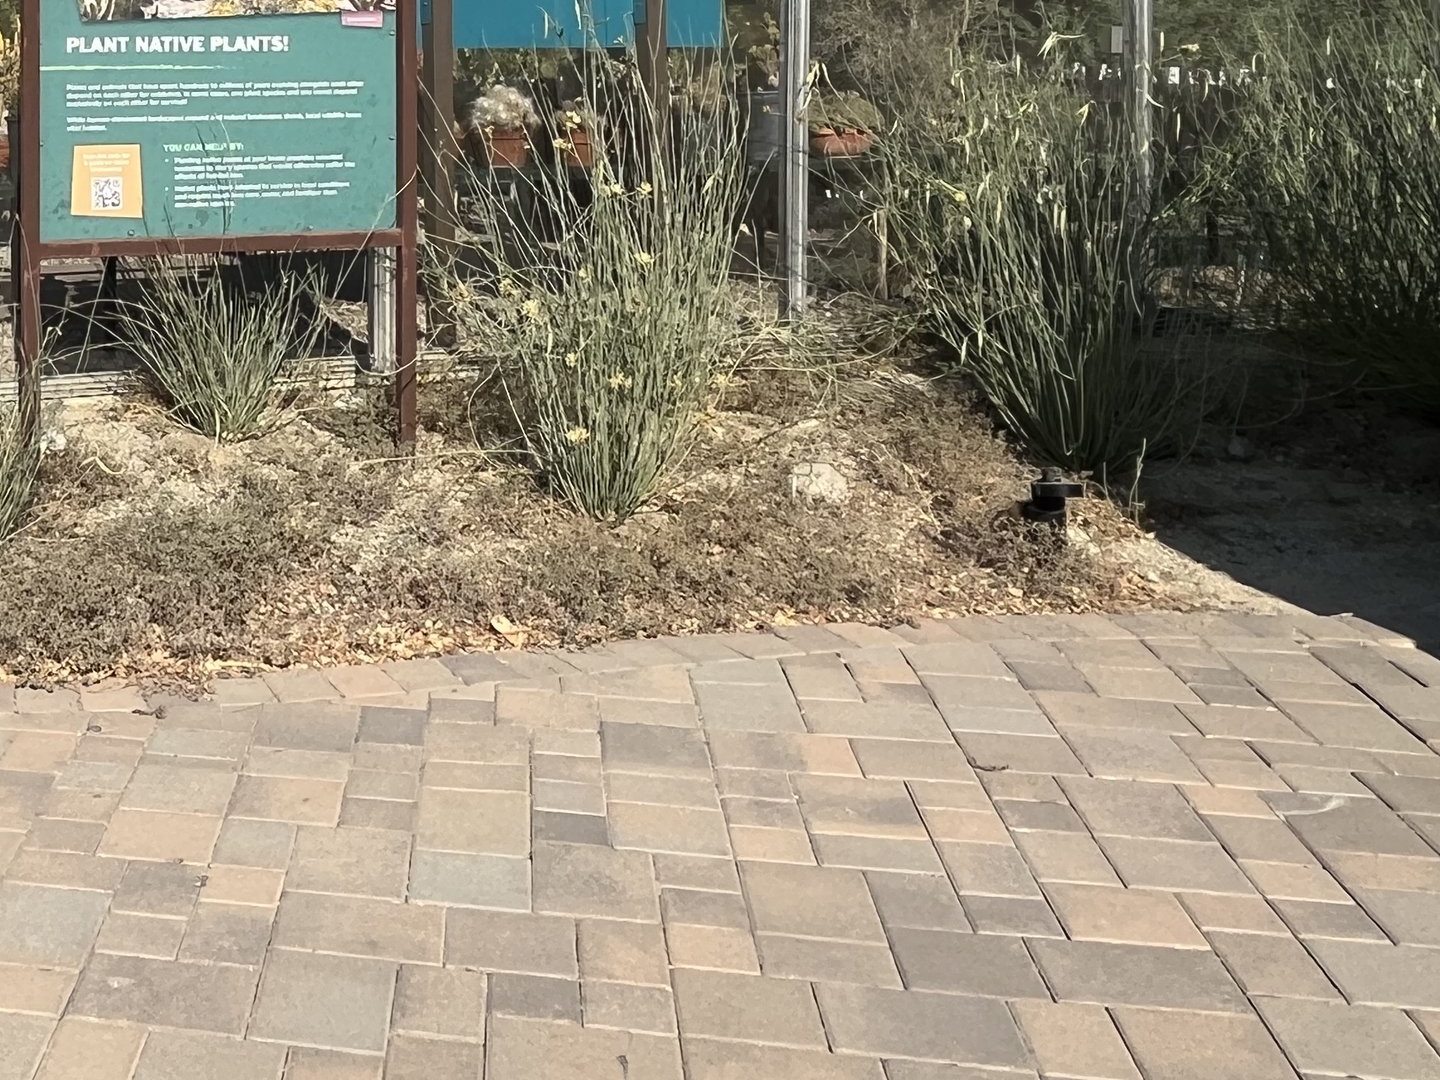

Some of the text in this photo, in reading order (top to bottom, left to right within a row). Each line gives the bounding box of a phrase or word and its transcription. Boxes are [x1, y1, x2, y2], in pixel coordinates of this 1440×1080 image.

[66, 35, 290, 53] PLANT NATIVE PLANTS!
